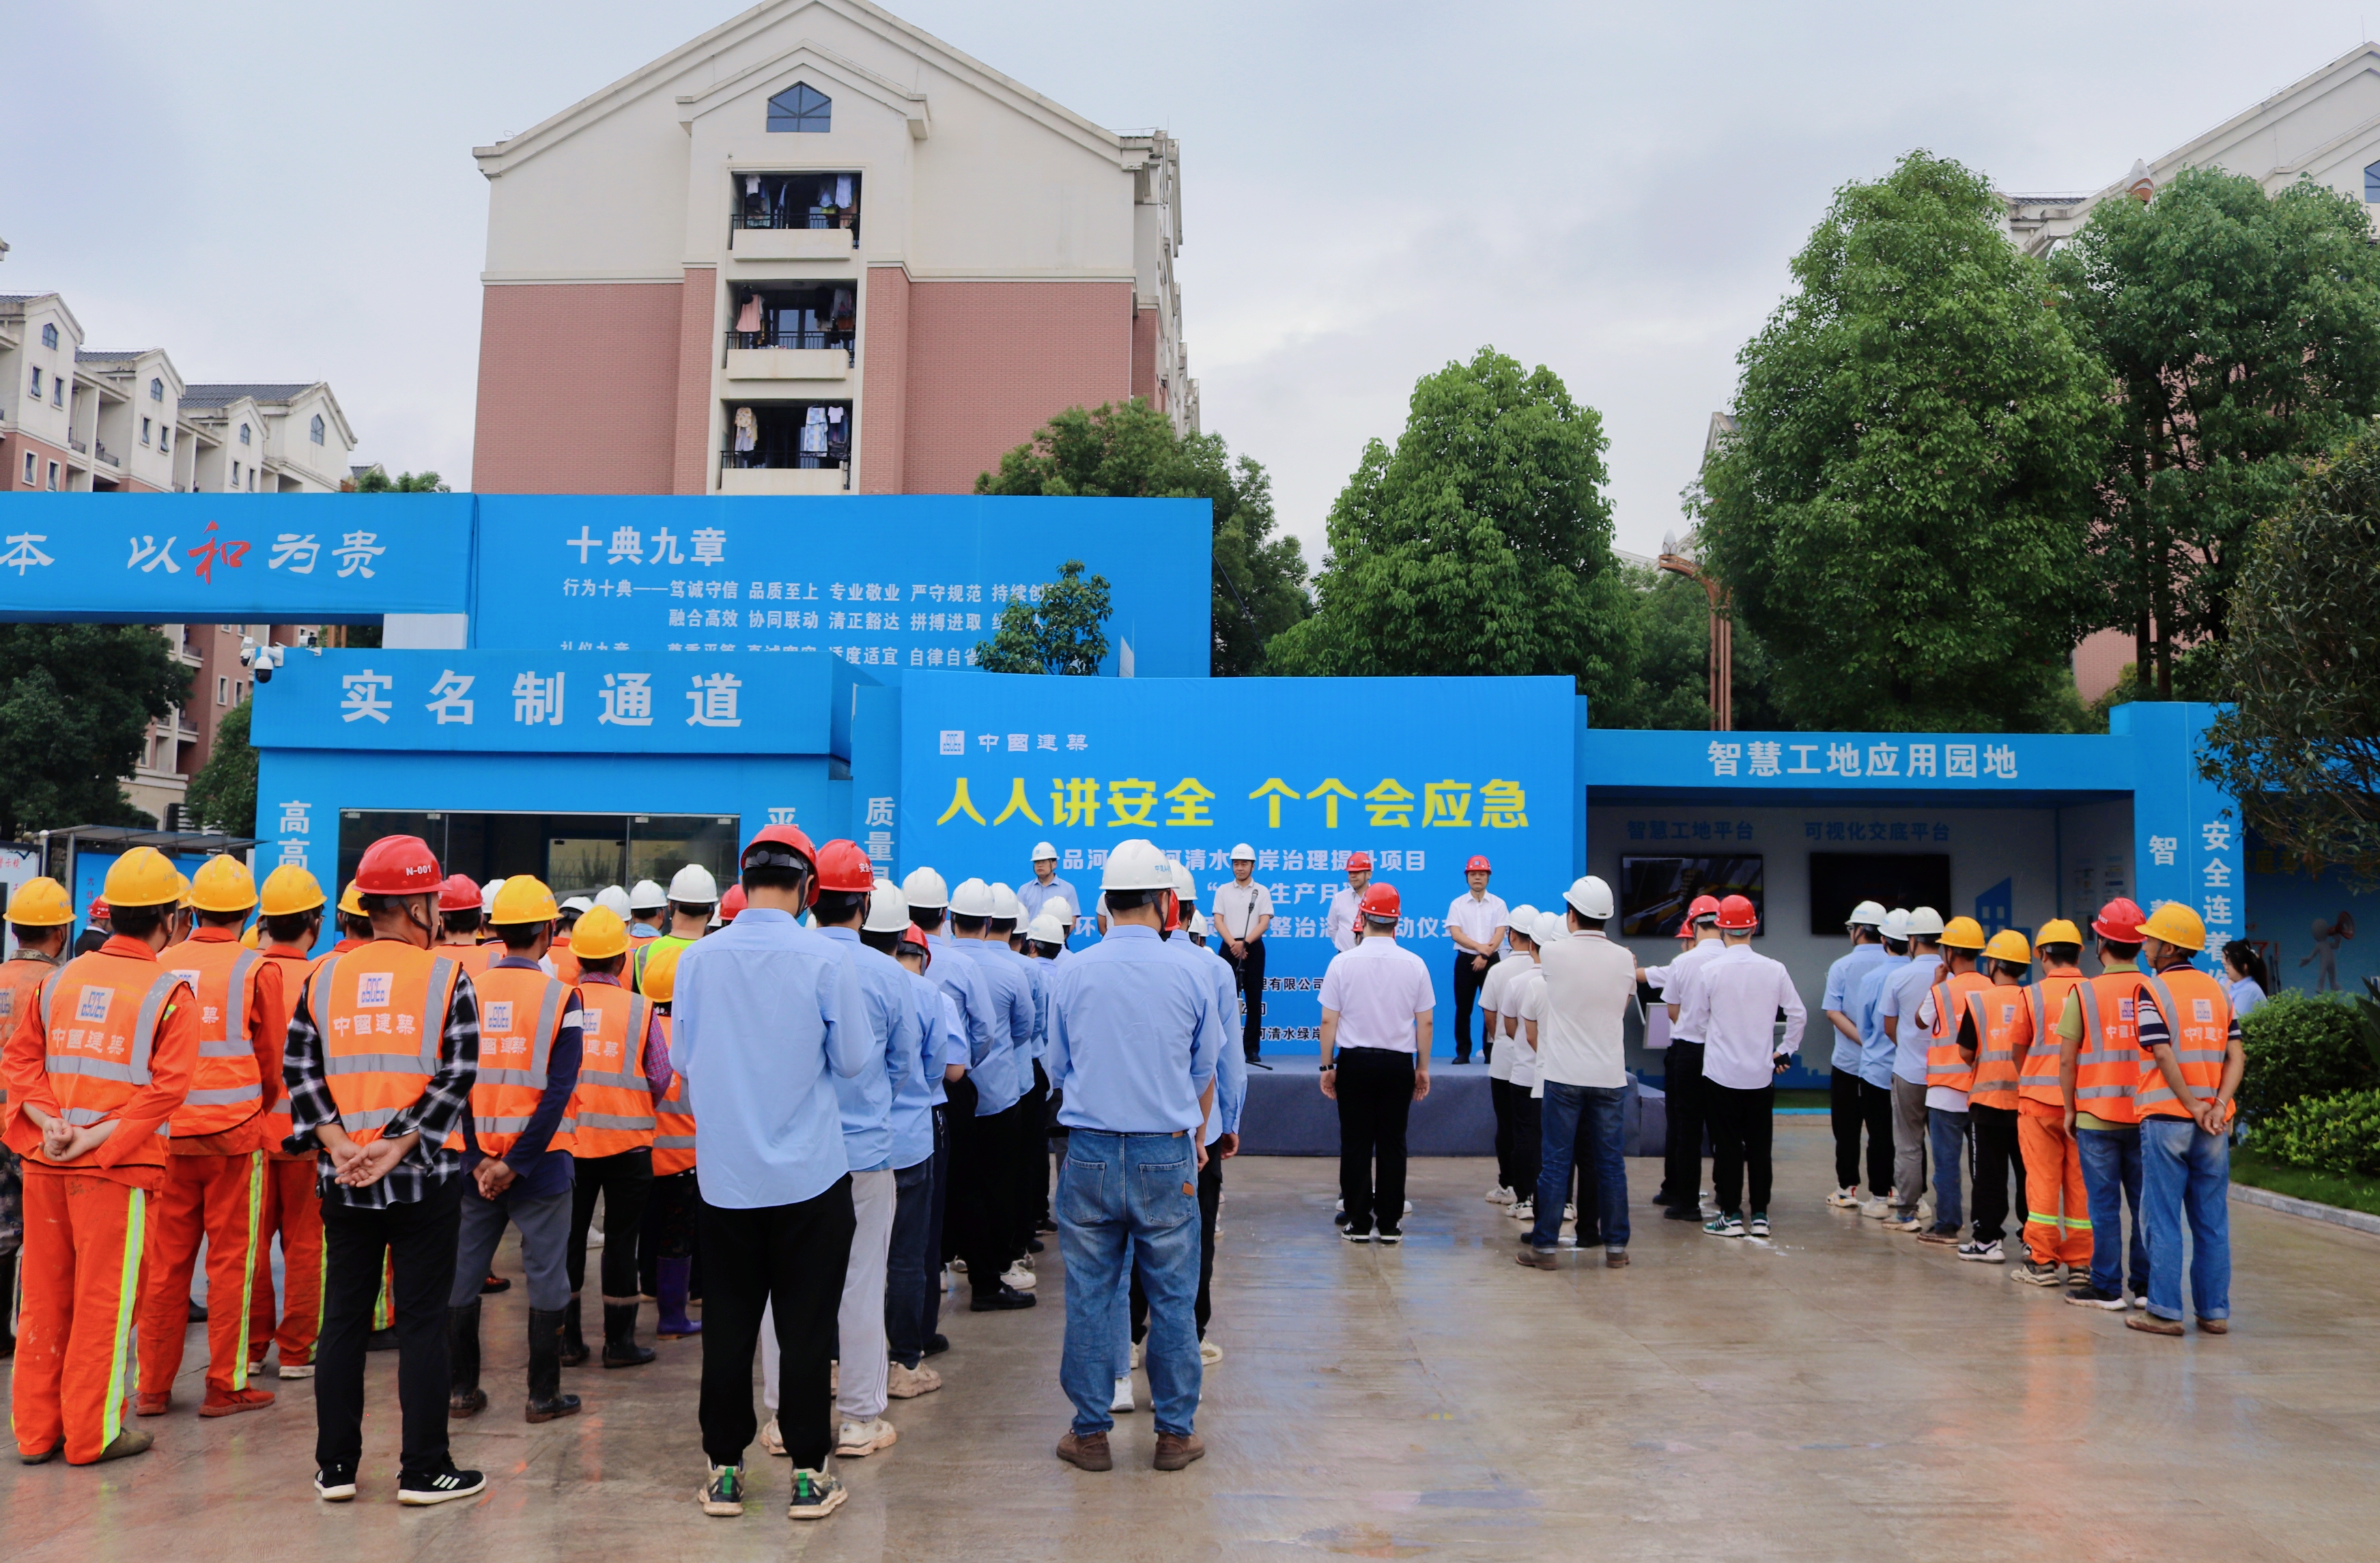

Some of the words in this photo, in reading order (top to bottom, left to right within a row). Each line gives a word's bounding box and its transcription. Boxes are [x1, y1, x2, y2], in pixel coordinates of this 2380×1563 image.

[0, 531, 55, 576] 本
[127, 520, 386, 585] 以和为贵
[567, 526, 727, 567] 十典九章
[748, 582, 819, 600] 品质至上
[829, 582, 900, 602] 专业敬业
[911, 584, 982, 603] 严守规范
[991, 584, 1061, 603] 持续创
[668, 608, 738, 628] 融合高效
[748, 610, 819, 630] 协同联动
[829, 612, 900, 631] 清正豁达
[911, 613, 981, 632] 拼搏进取
[340, 669, 743, 727] 实名制通道
[1708, 740, 2019, 780] 智慧工地应用园地
[937, 777, 1216, 828] 人人讲安全
[1249, 777, 1530, 829] 个个会应急
[1628, 820, 1754, 841] 智慧工地平台
[1804, 821, 1950, 843] 可视化交底平台
[406, 864, 432, 876] N-001
